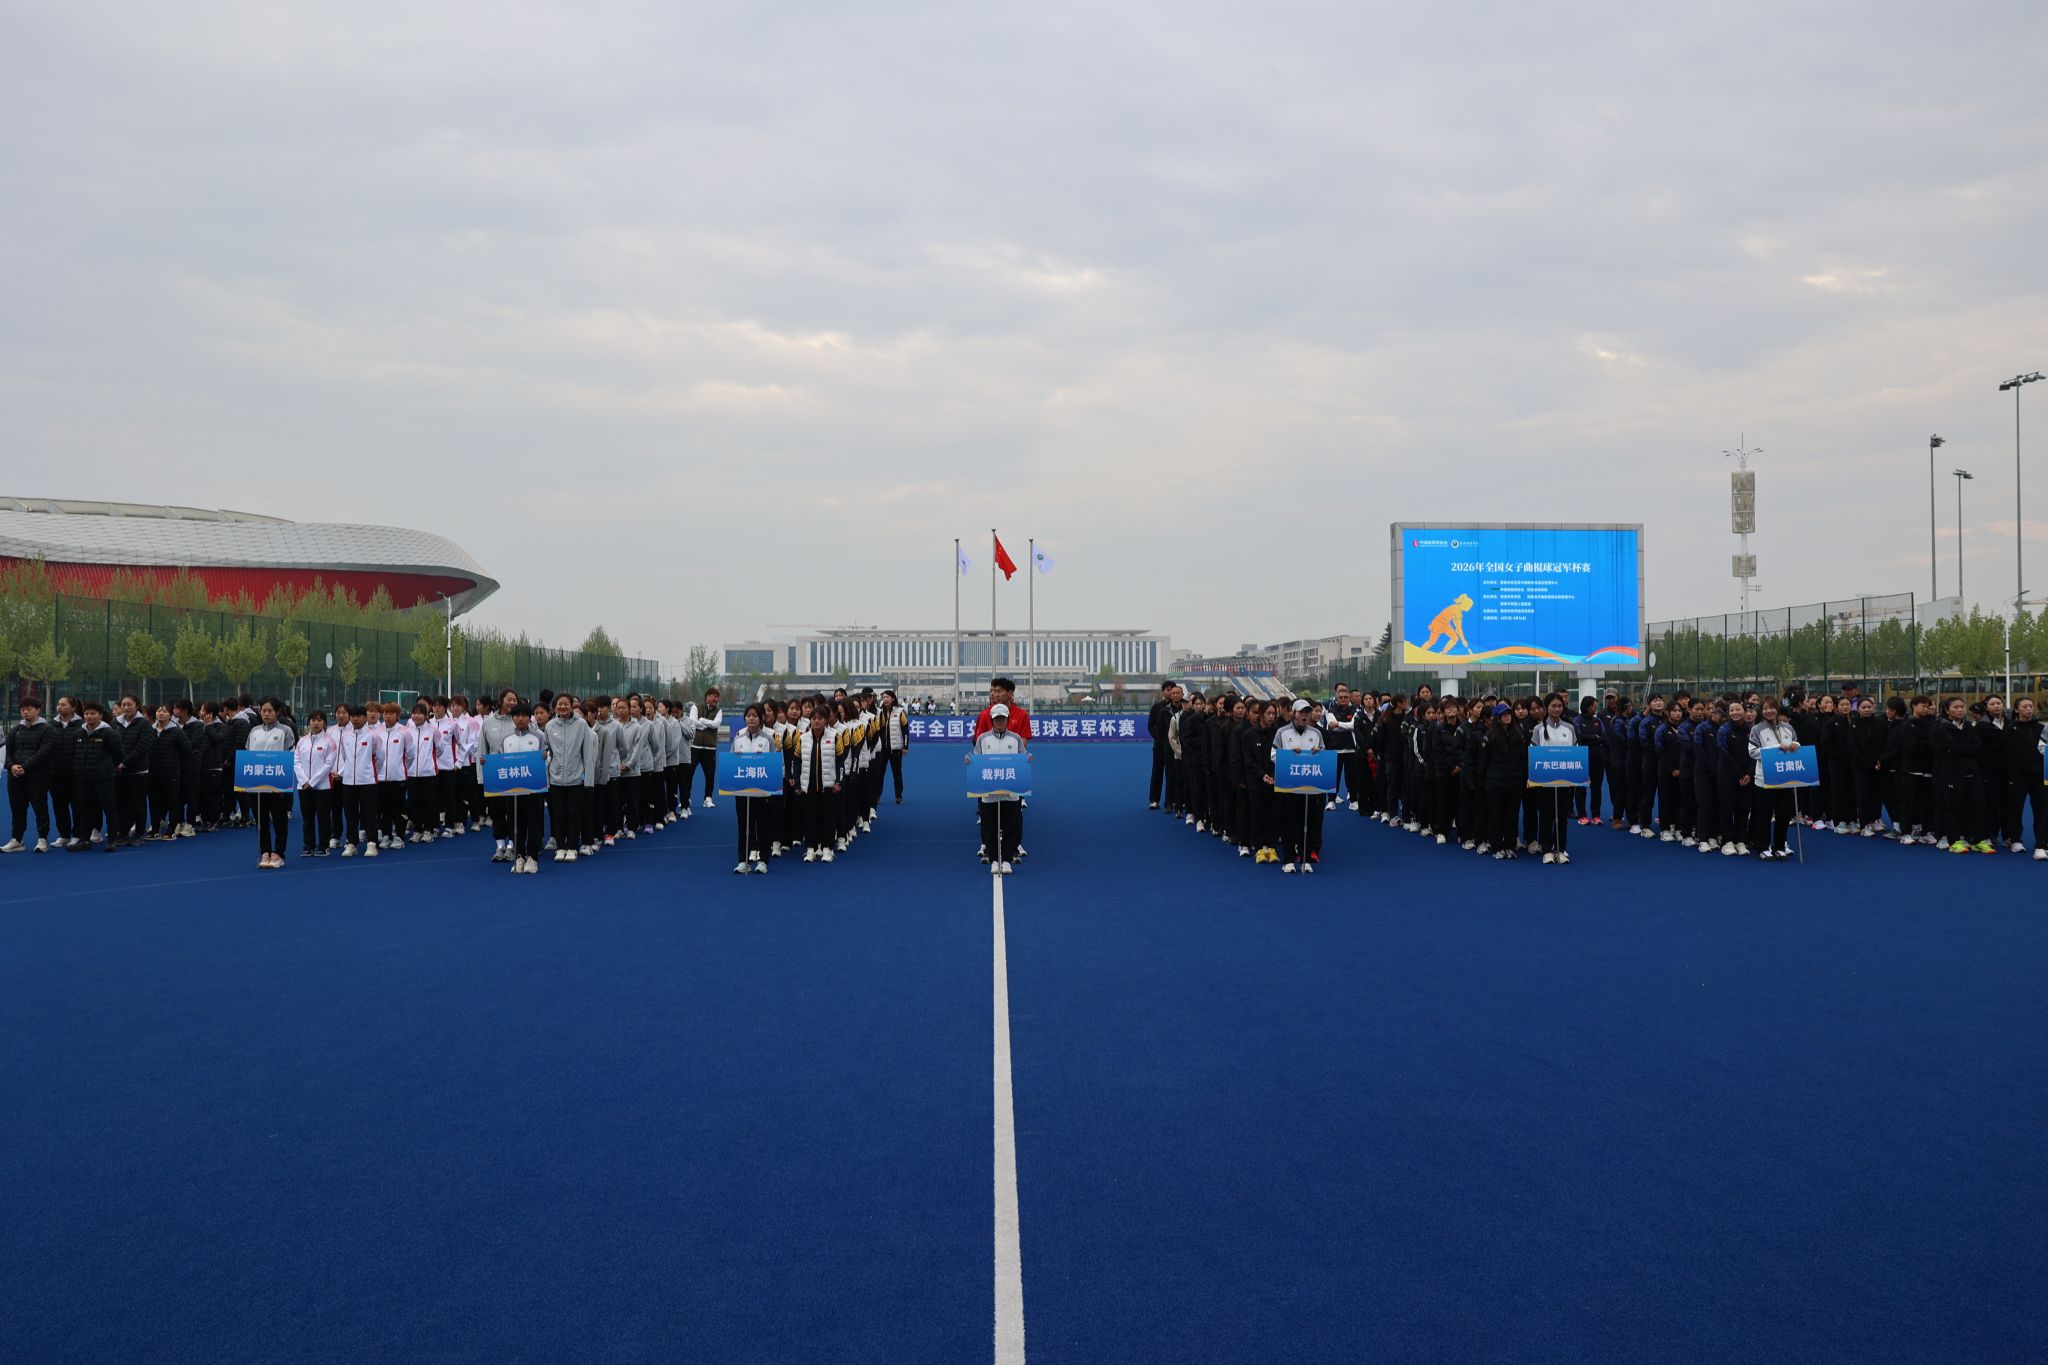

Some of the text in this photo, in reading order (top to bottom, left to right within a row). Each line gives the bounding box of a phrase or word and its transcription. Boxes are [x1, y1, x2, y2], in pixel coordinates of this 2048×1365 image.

[1451, 562, 1591, 573] 2026年全国女子曲棍球冠军杯赛
[243, 764, 285, 776] 内蒙古队
[497, 765, 532, 779] 吉林队
[734, 766, 768, 778] 上海队
[1290, 764, 1323, 776] 江苏队
[1775, 760, 1806, 772] 甘肃队
[982, 767, 1016, 780] 裁判员
